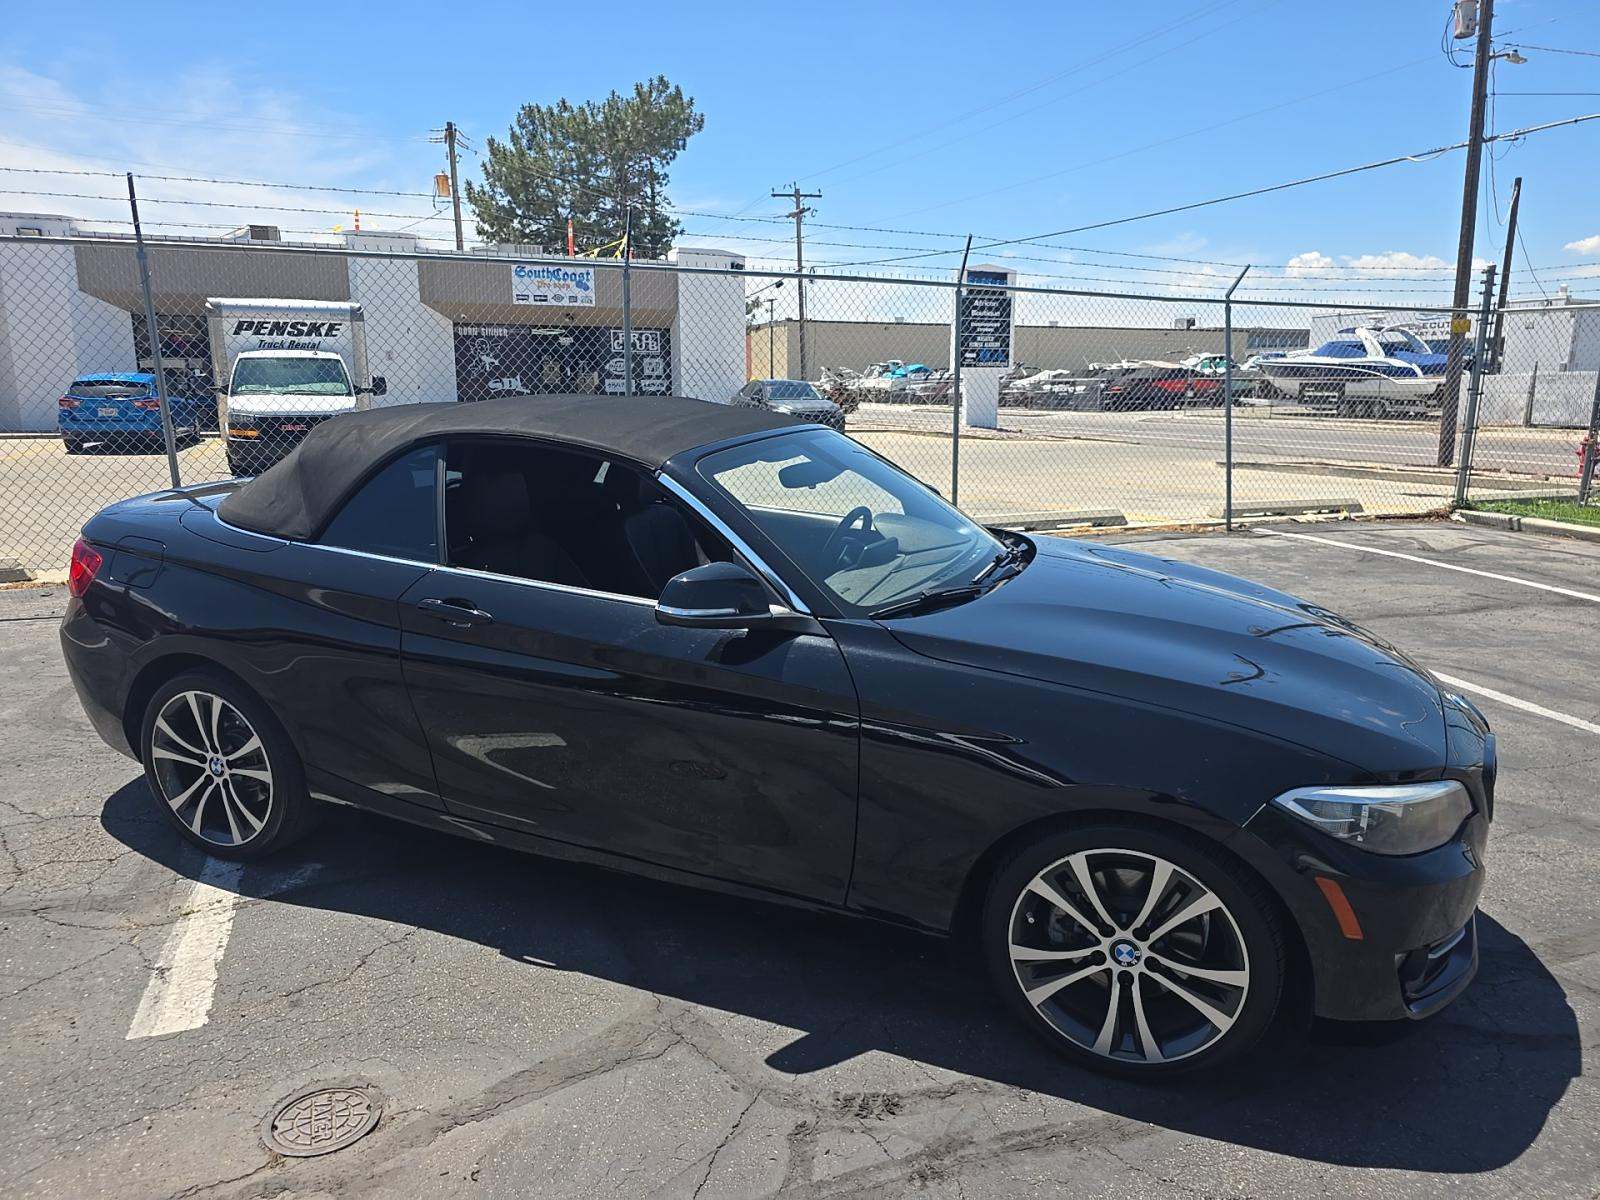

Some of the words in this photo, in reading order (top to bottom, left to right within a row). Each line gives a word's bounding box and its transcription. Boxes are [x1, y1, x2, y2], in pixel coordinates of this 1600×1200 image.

[233, 321, 343, 338] PENSKE
[258, 339, 284, 349] Truck
[287, 340, 322, 350] Rental
[614, 340, 658, 351] CUB
